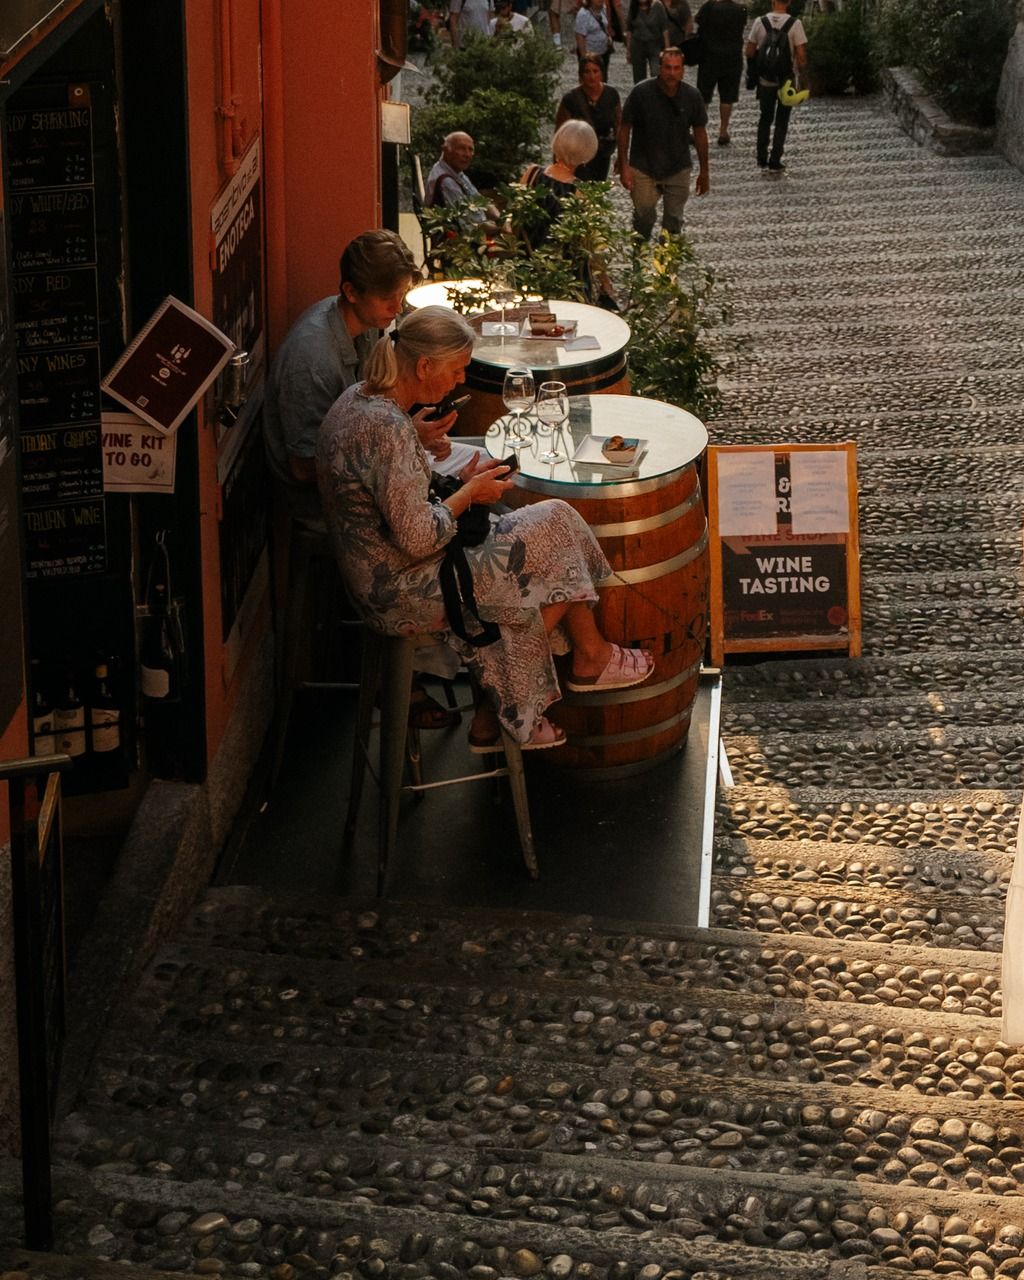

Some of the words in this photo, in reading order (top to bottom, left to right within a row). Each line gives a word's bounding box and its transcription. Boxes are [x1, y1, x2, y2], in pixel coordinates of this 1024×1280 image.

[32, 110, 89, 130] SPARKLING
[30, 191, 91, 214] WHITE/RED
[219, 195, 256, 274] ENOTECA
[46, 273, 71, 292] RED
[46, 353, 87, 373] WINES
[21, 431, 57, 454] TALIAN
[141, 434, 166, 450] KIT
[106, 451, 126, 466] TO
[130, 452, 152, 467] GO
[24, 509, 67, 532] TALIAN
[72, 504, 101, 528] WINE
[756, 556, 813, 574] WINE
[739, 576, 831, 595] TASTING
